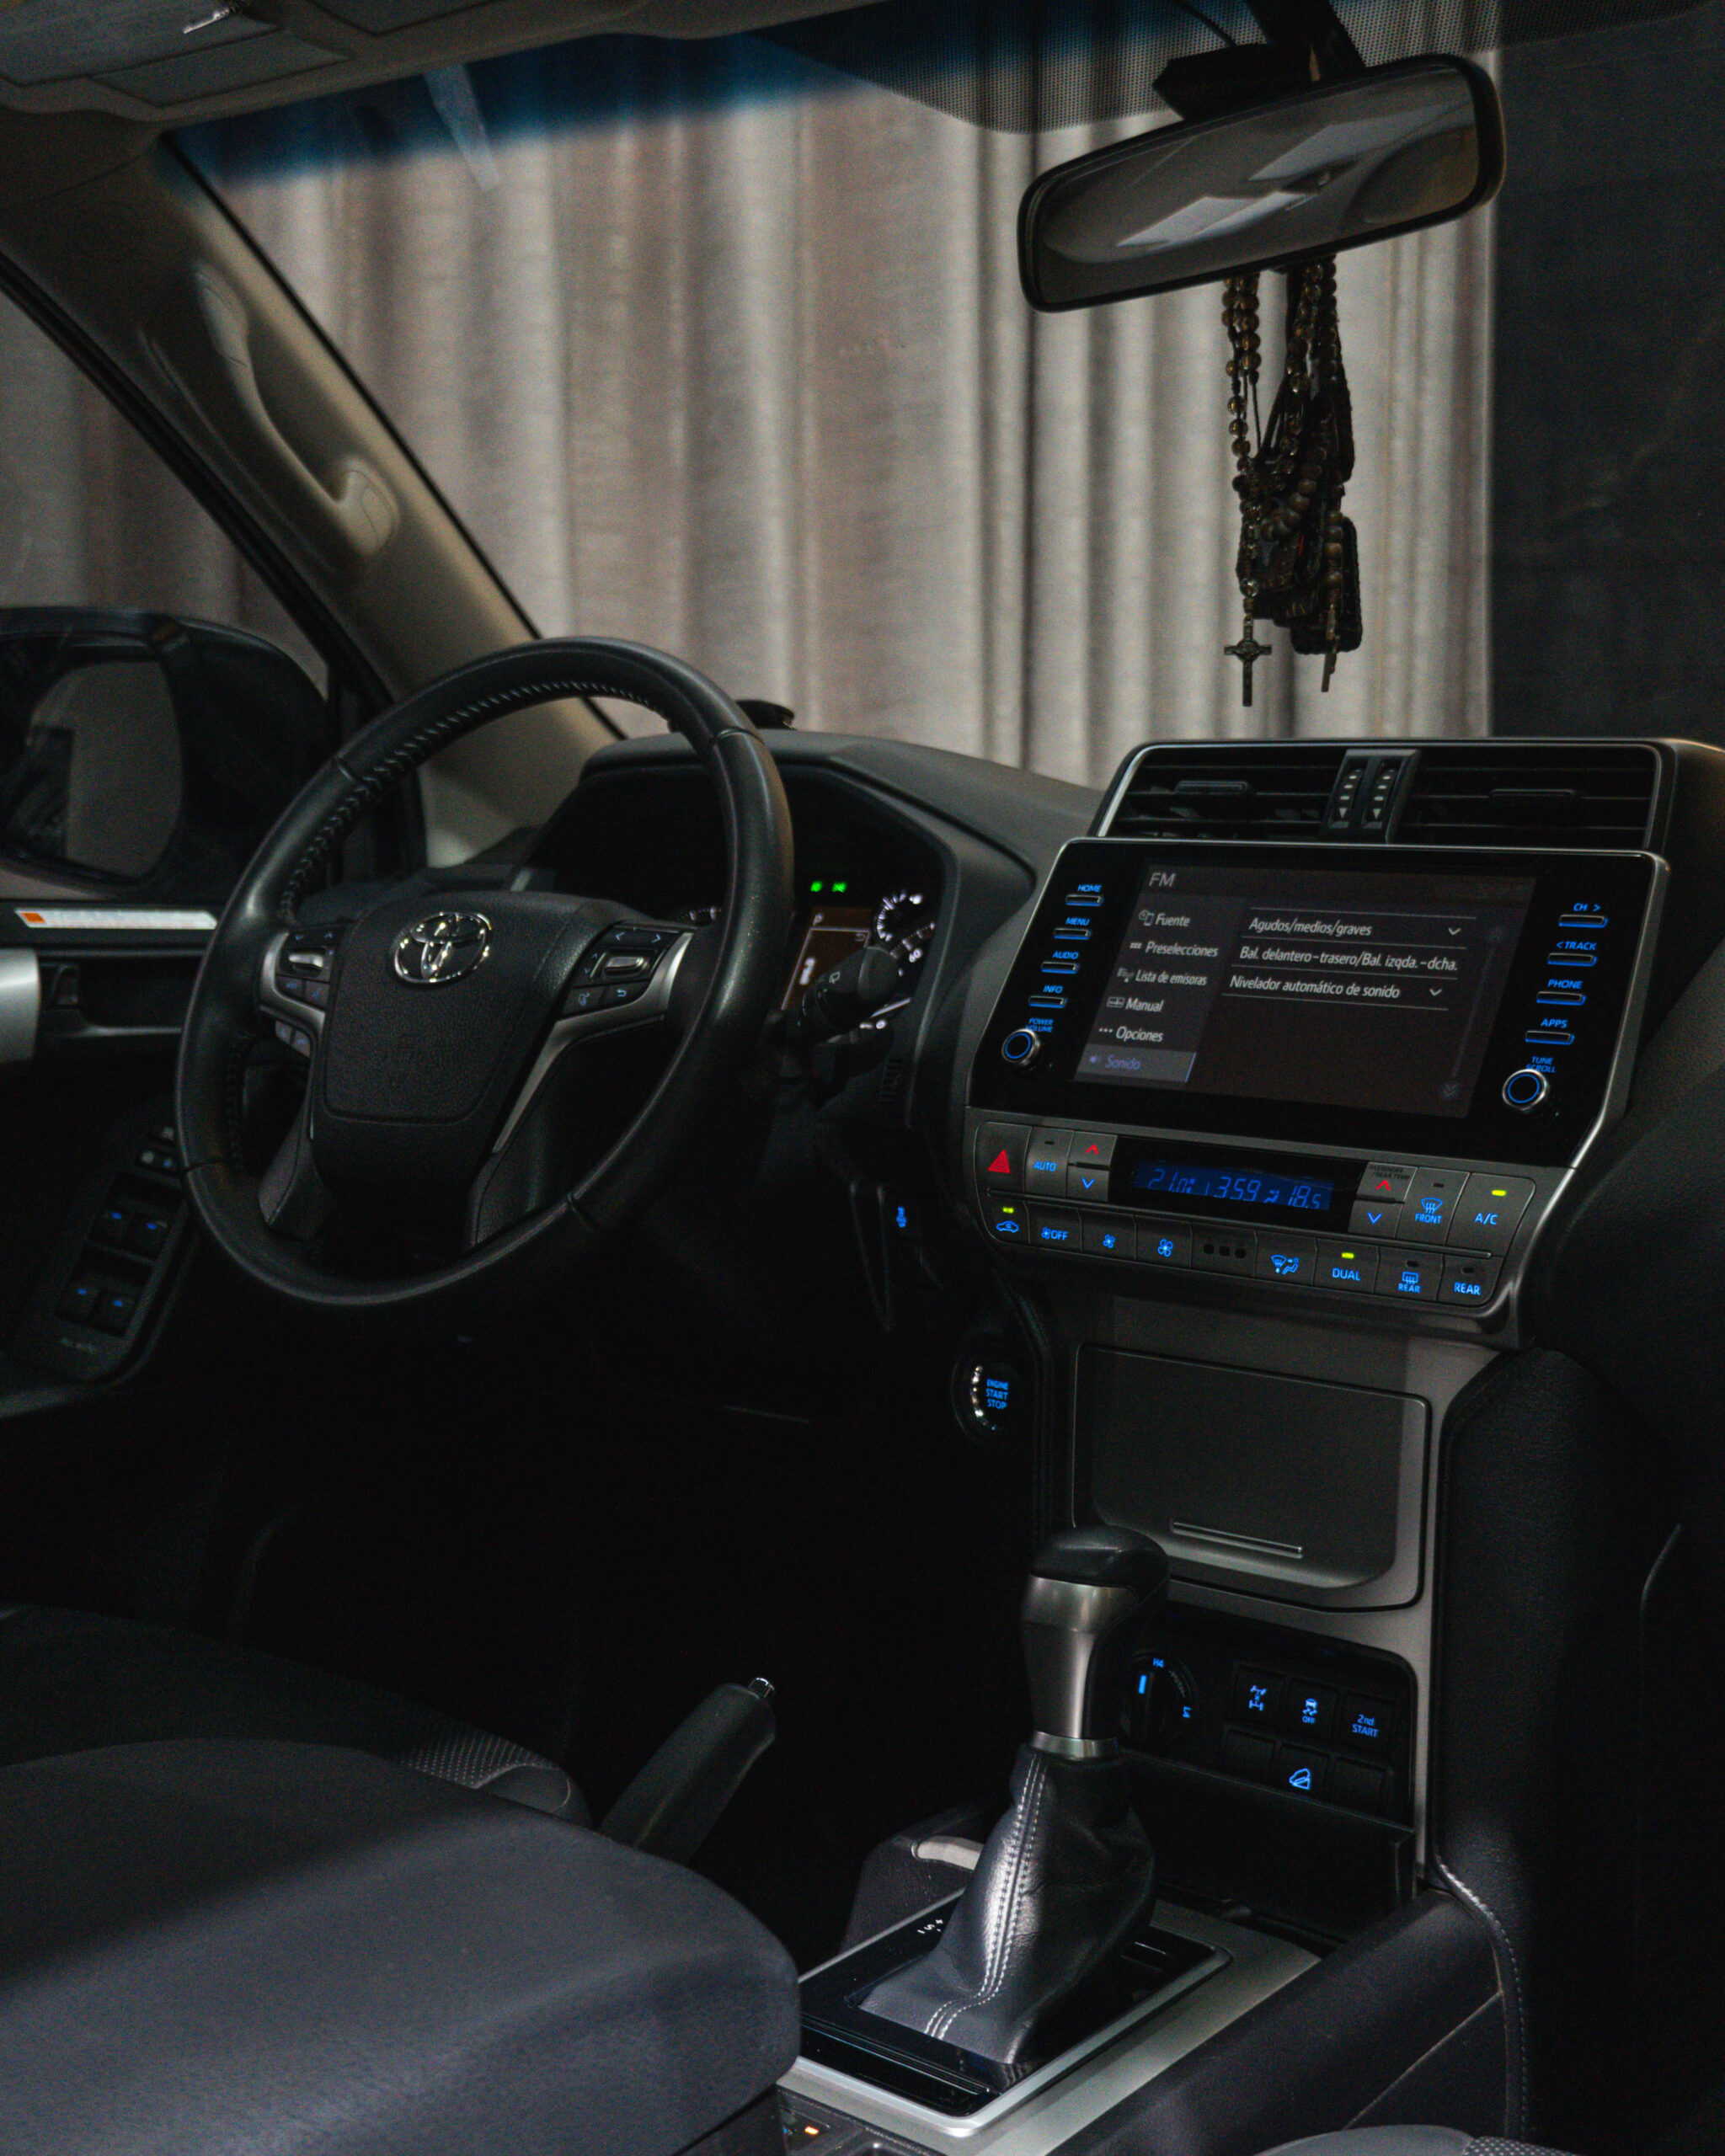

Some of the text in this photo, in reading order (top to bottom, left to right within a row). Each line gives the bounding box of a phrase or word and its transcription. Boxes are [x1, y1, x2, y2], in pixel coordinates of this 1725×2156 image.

[1149, 873, 1176, 887] FM
[1077, 884, 1102, 893] HOME
[1573, 903, 1589, 912] CH
[1065, 917, 1090, 926] MENU
[1156, 913, 1190, 926] Fuente
[1248, 917, 1372, 937] Agudos/medios/graves
[1052, 951, 1080, 960] AUDIO
[1146, 941, 1219, 958] Preselecciones
[1240, 946, 1258, 960] Bal.
[1135, 969, 1208, 986] Lista de emisoras
[1043, 985, 1063, 994] INFO
[1230, 975, 1400, 999] Nivelador automático de sonido
[1547, 979, 1583, 990] PHONE
[1125, 997, 1164, 1012] Manual
[1028, 1017, 1054, 1026] POWER
[1540, 1018, 1568, 1028] APPS
[1116, 1026, 1164, 1042] Opciones
[1105, 1055, 1140, 1070] Sonido
[1530, 1056, 1553, 1065] TUNE
[1033, 1161, 1056, 1171] AUTO
[1414, 1214, 1443, 1225] FRONT
[1475, 1213, 1498, 1225] A/C
[1050, 1230, 1068, 1241] OFF
[1332, 1267, 1361, 1282] DUAL
[1398, 1283, 1421, 1294] REAR
[1454, 1282, 1481, 1296] REAR
[985, 1388, 1009, 1401] START
[986, 1398, 1007, 1410] STOP
[1357, 1713, 1375, 1726] 2nd
[1352, 1723, 1379, 1738] START
